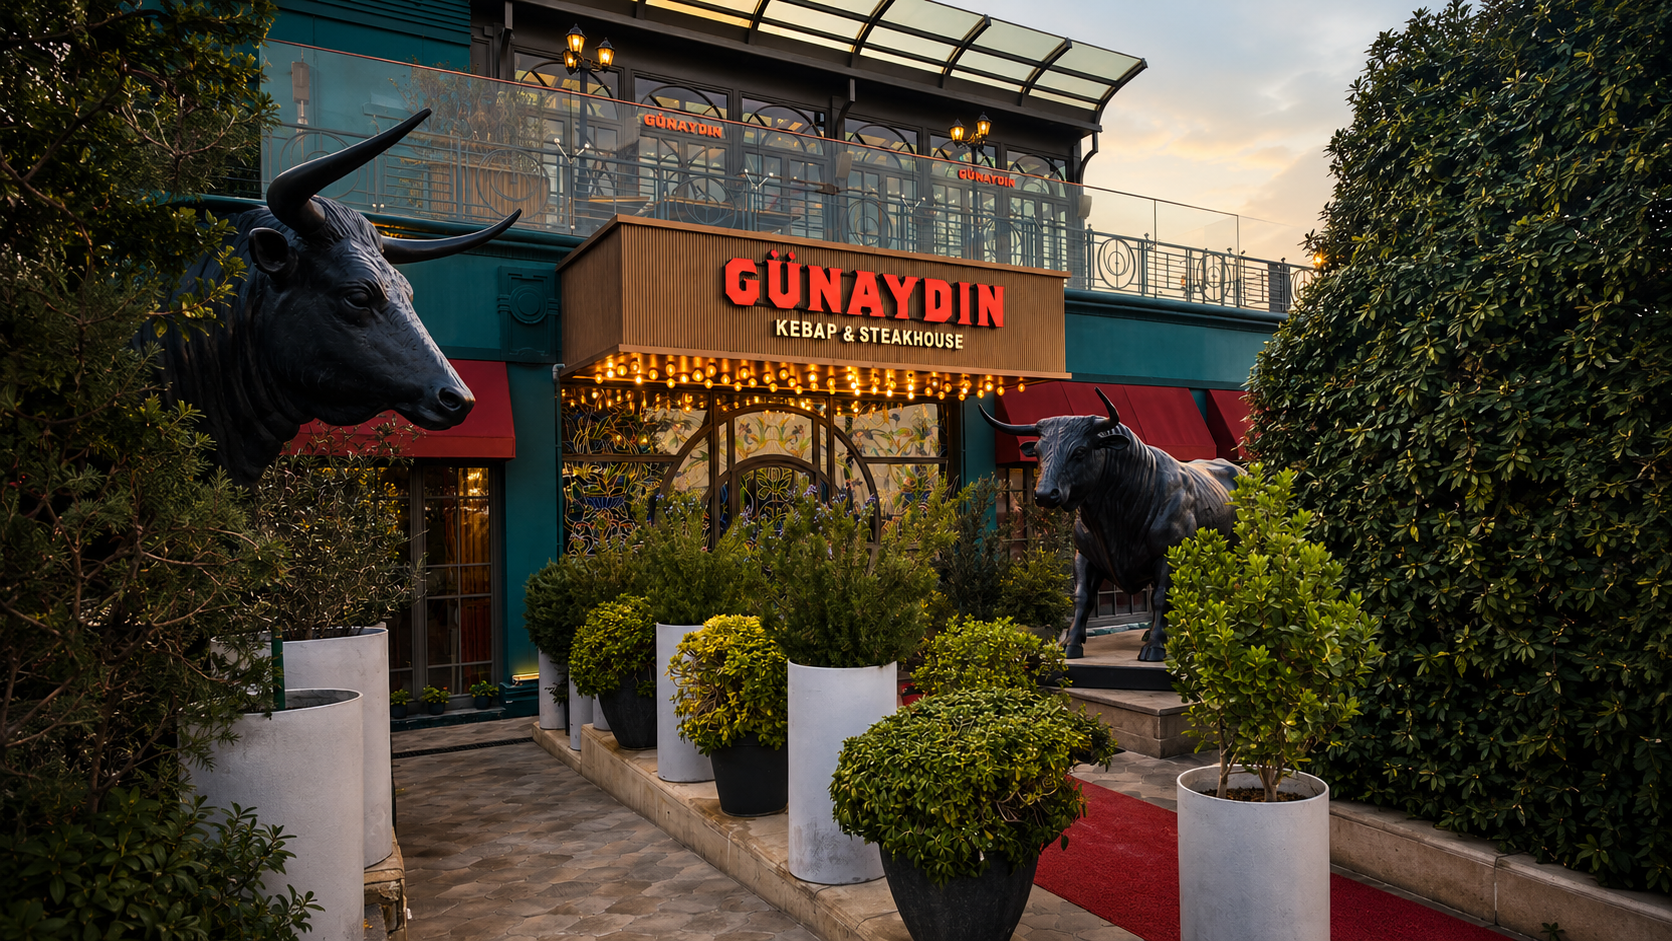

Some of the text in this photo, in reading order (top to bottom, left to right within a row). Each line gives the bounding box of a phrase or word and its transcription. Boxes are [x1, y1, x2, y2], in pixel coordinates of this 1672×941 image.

[724, 249, 1005, 328] GÜNAYDIN
[776, 319, 964, 349] KEBAP & STEAKHOUSE
